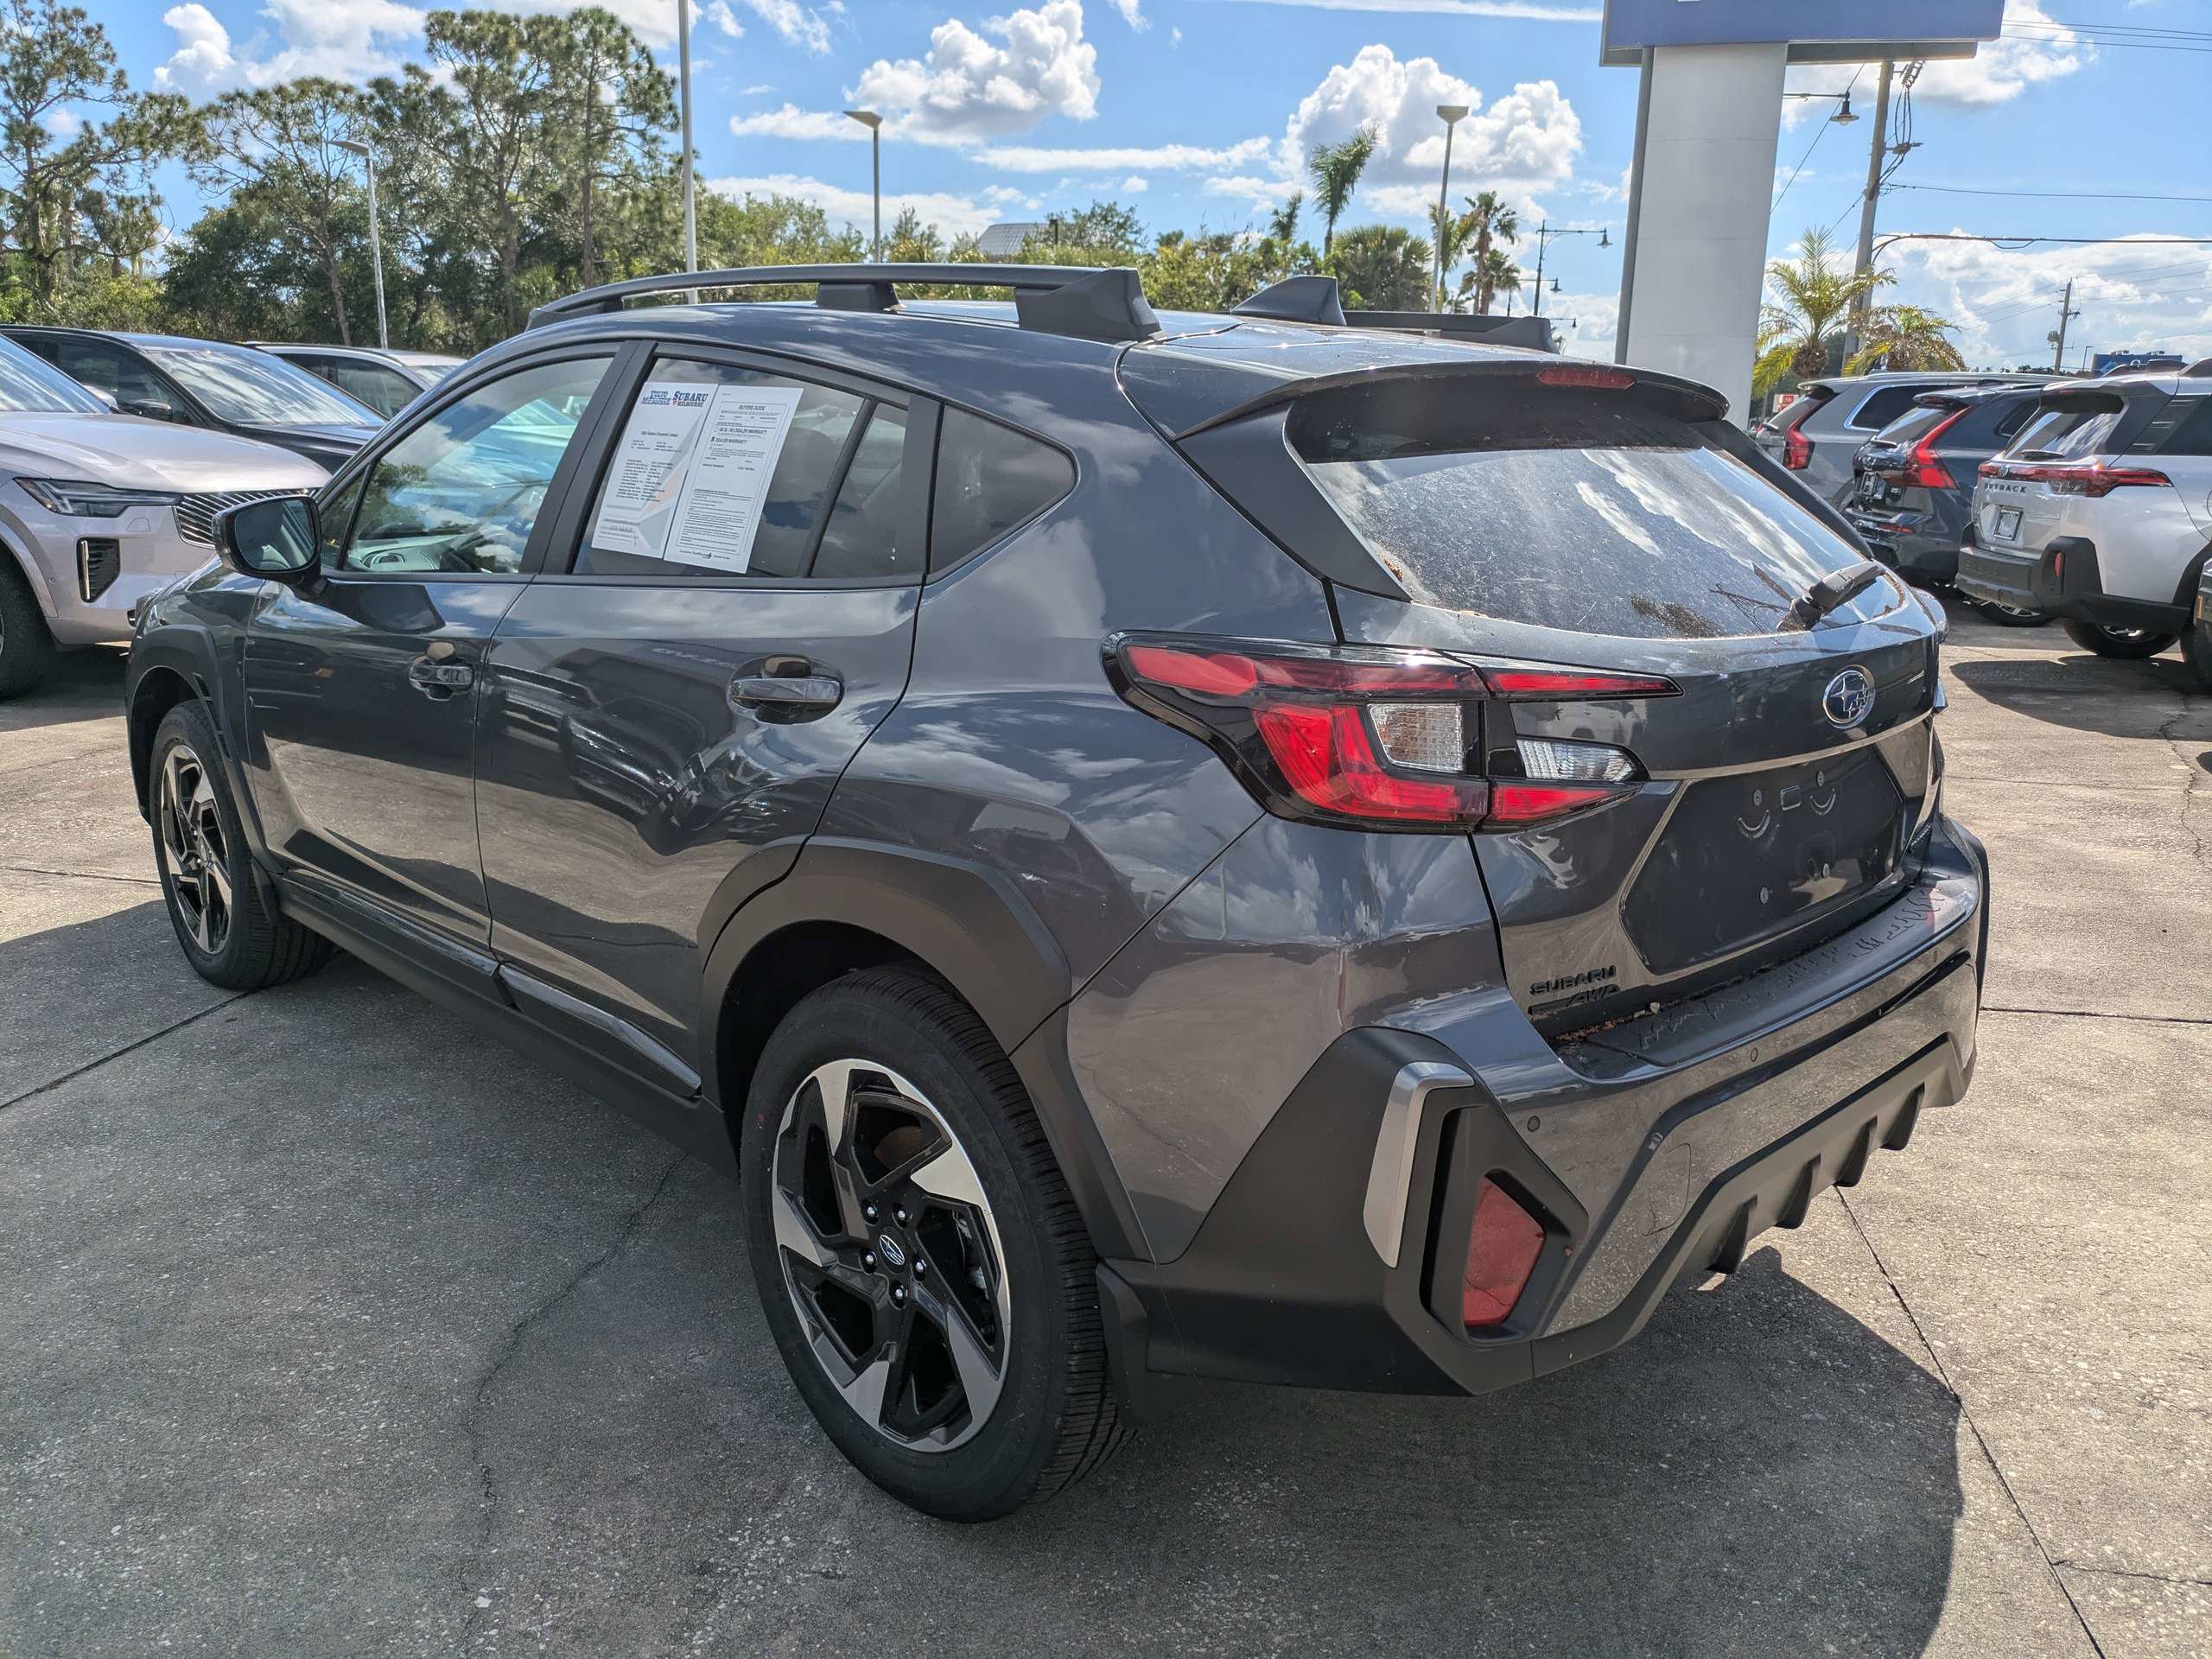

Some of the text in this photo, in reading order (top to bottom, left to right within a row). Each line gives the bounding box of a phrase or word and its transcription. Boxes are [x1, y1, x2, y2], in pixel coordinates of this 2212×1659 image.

[672, 391, 709, 403] SUBARU
[1984, 483, 2027, 493] OUTBACK
[1529, 965, 1616, 995] SUBARU
